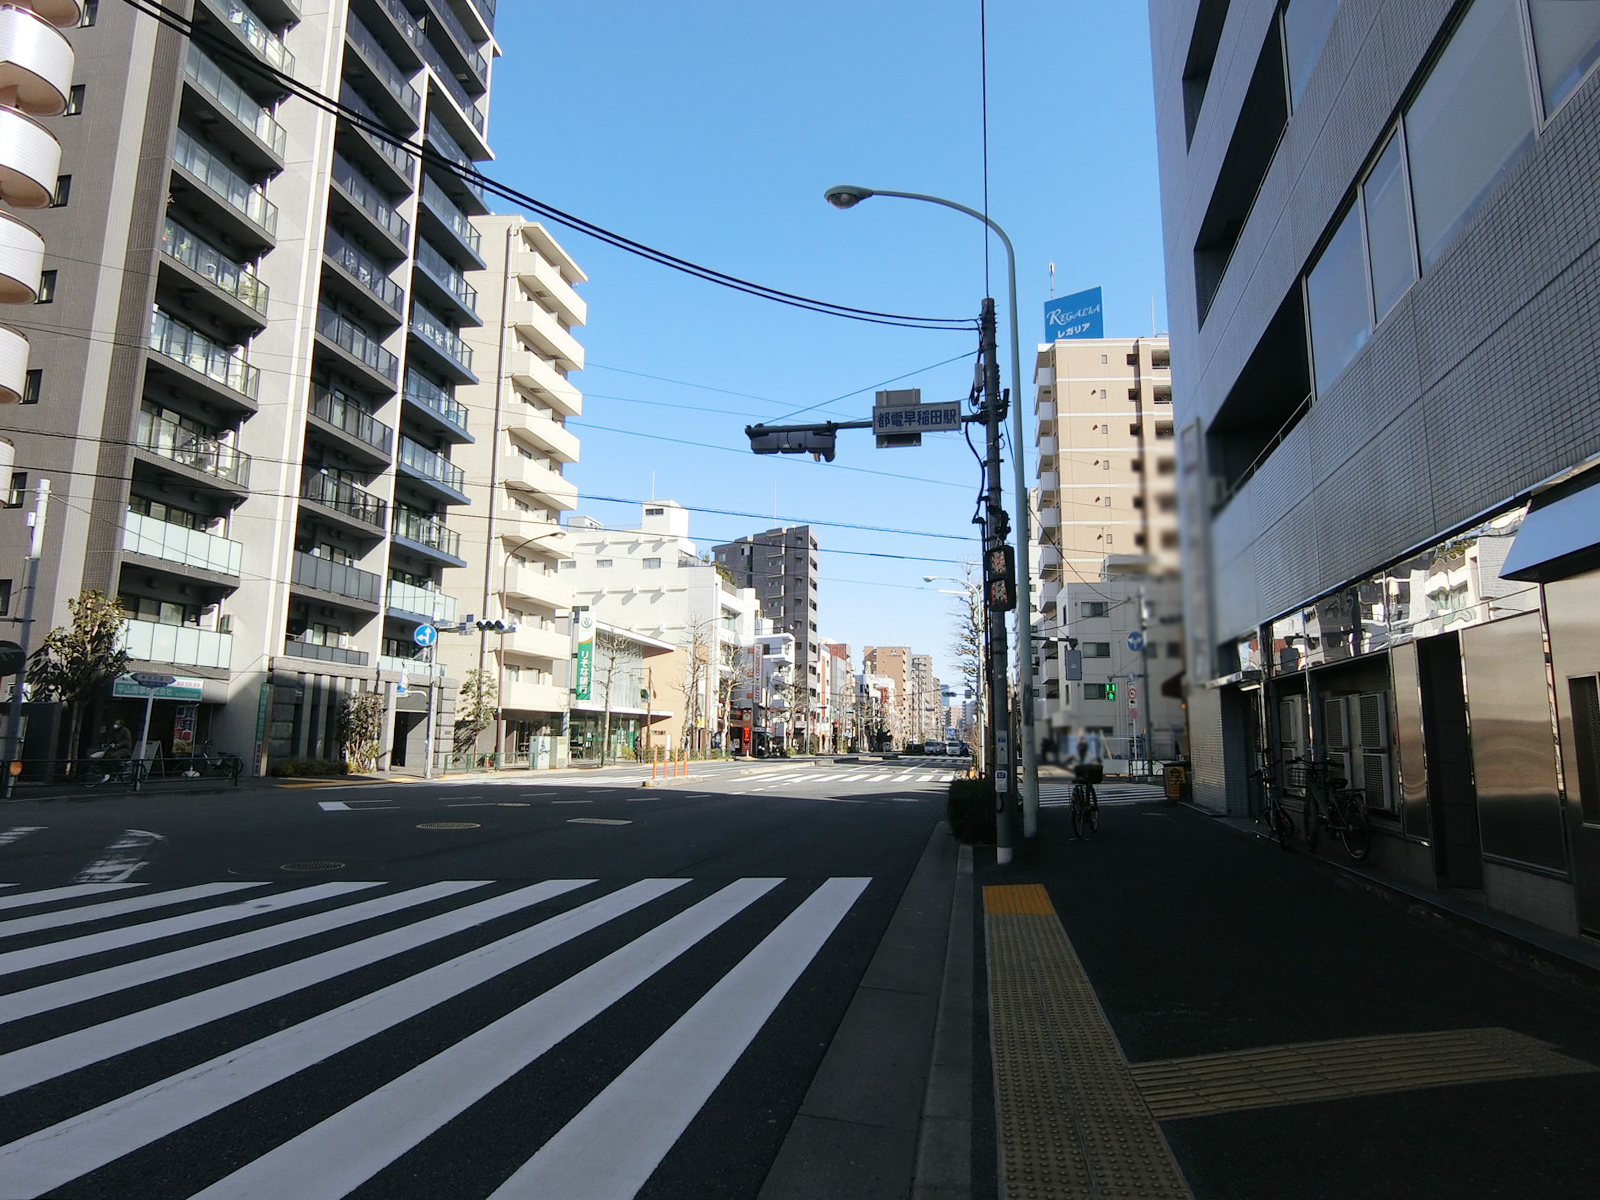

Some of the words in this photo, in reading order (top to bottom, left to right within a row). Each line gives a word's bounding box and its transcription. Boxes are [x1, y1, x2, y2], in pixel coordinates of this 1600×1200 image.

[1057, 322, 1090, 338] レガリア
[878, 409, 957, 427] 都電早稲田駅
[578, 650, 589, 694] りそな銀行
